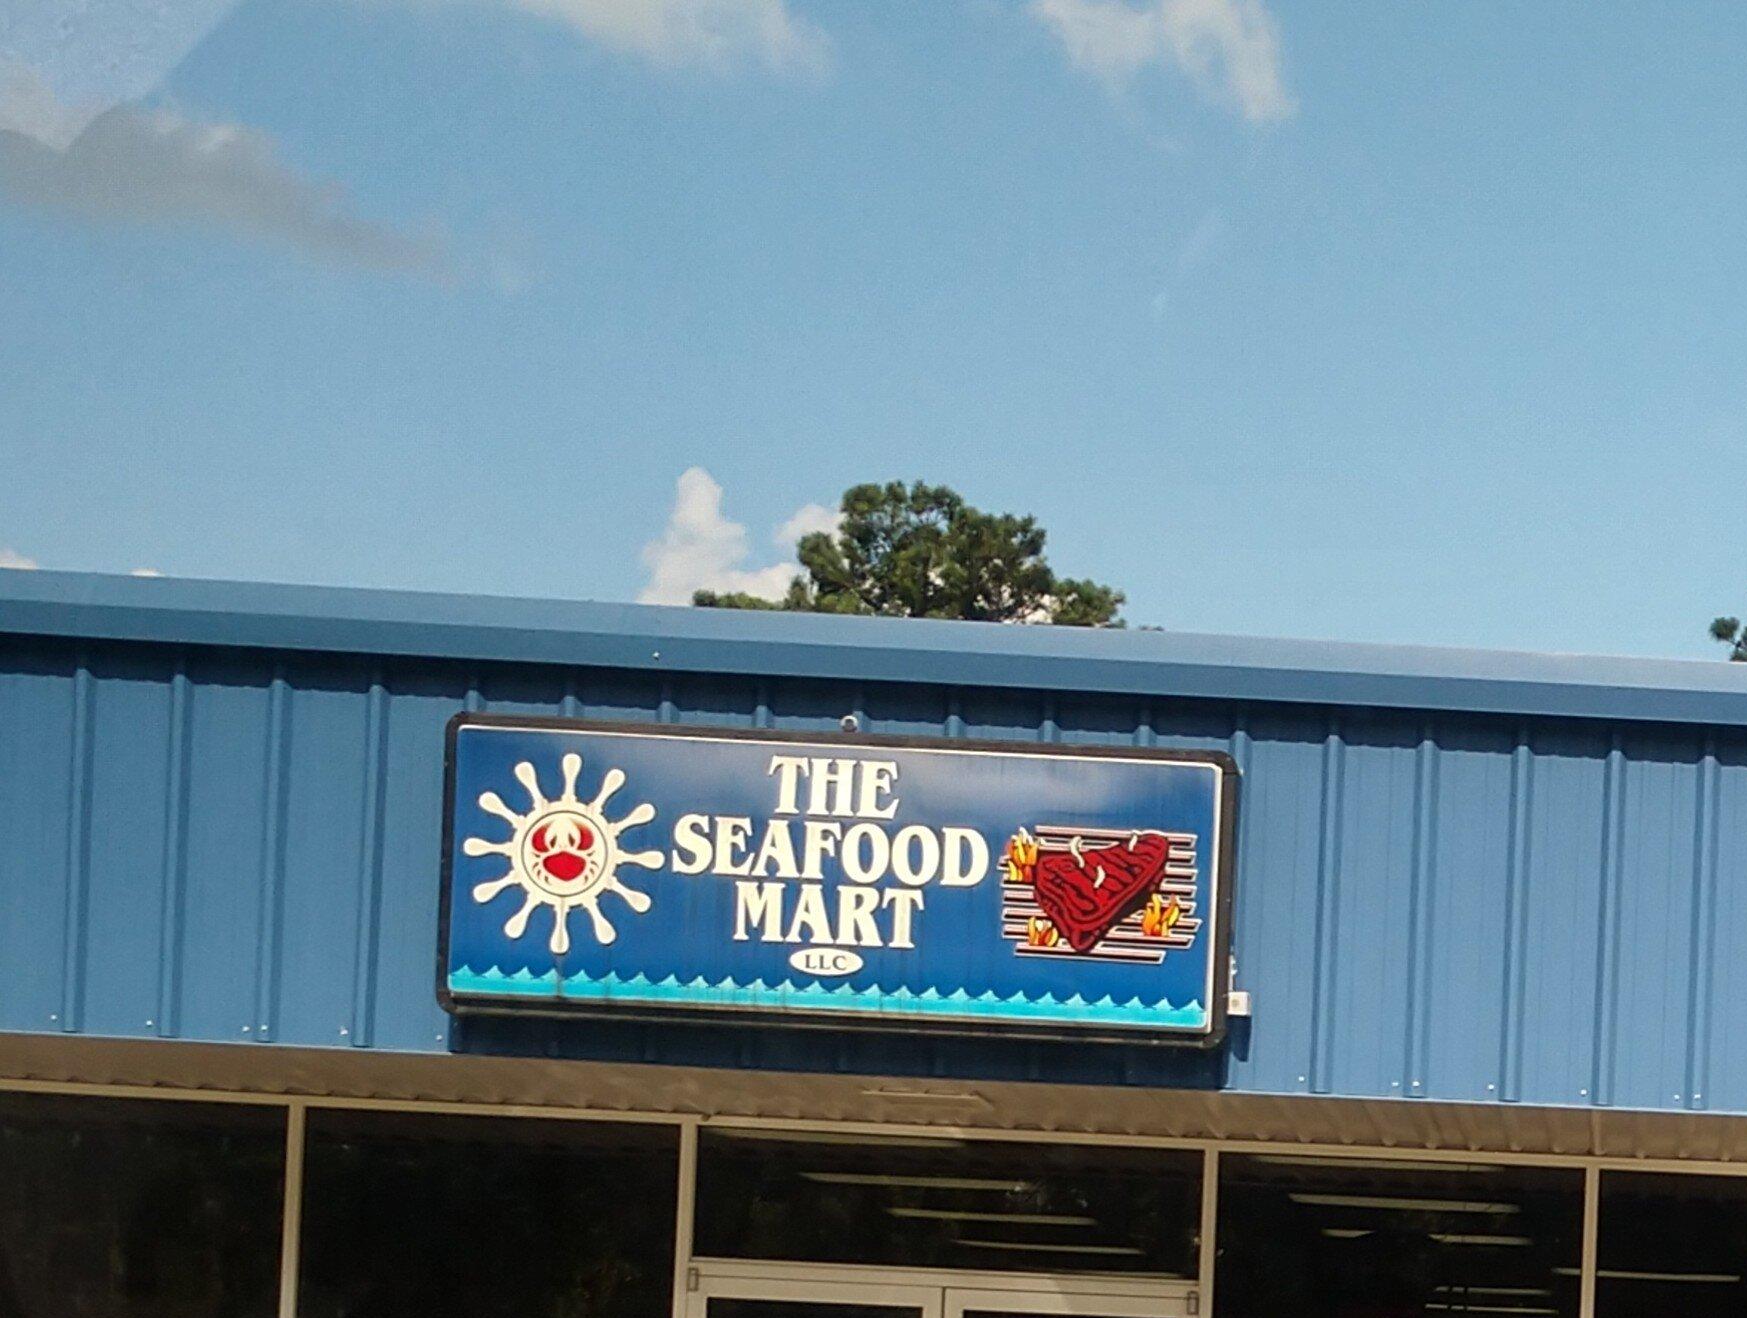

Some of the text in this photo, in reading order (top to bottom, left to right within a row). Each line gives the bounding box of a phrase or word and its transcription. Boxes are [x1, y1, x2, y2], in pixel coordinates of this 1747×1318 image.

[769, 755, 900, 820] THE
[672, 814, 988, 886] SEAFOOD
[733, 883, 925, 949] MART
[804, 953, 848, 971] LLC
